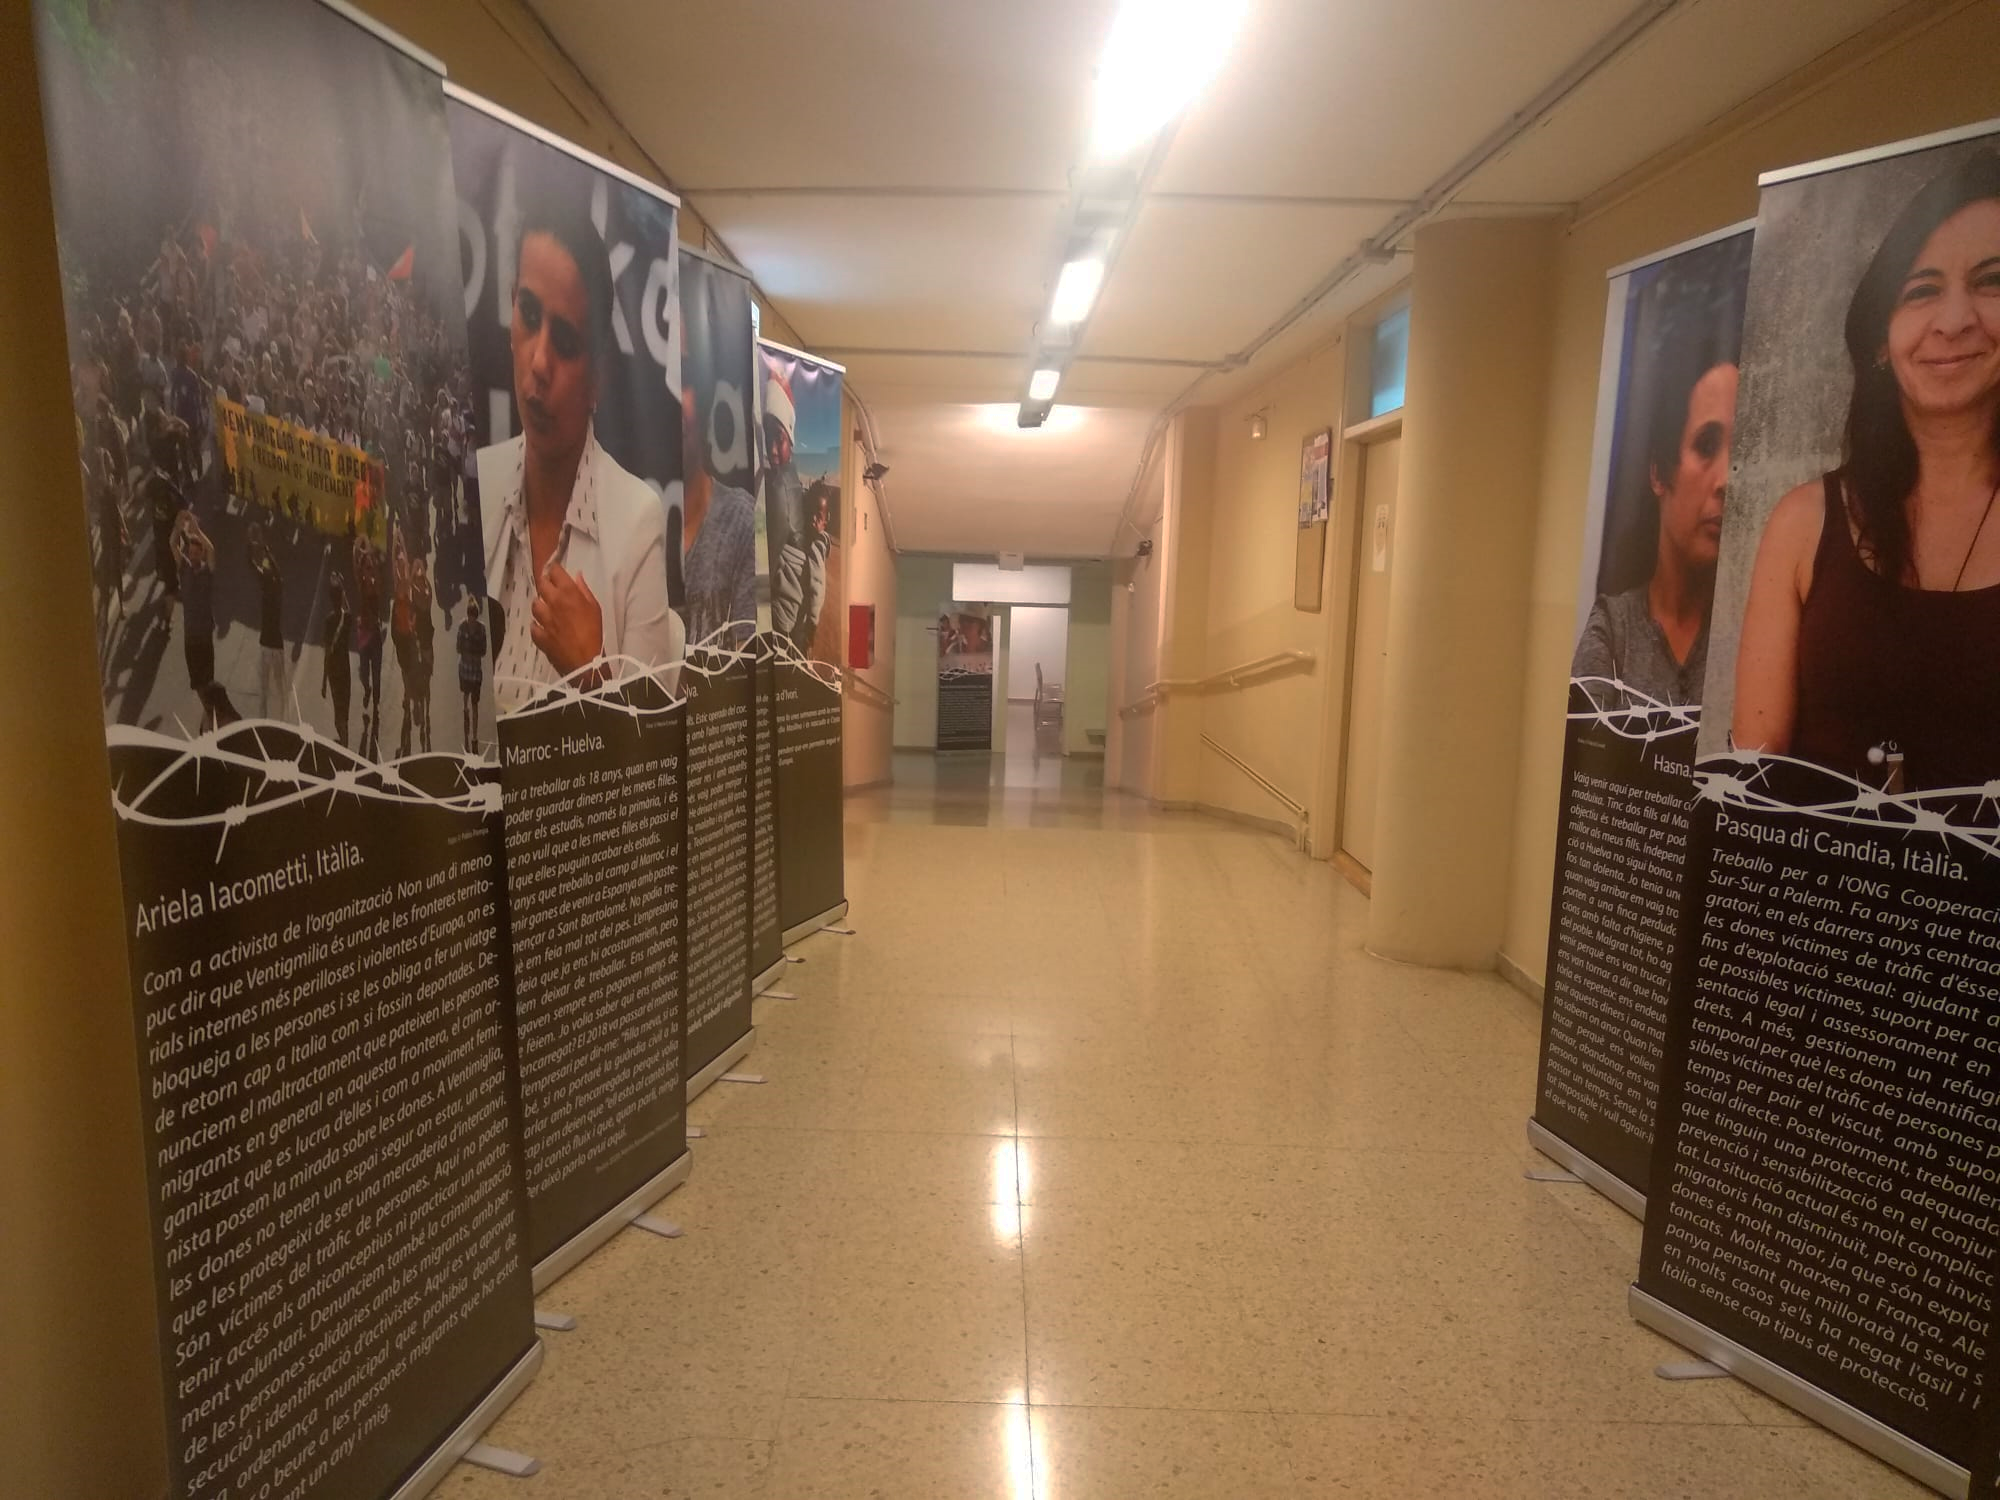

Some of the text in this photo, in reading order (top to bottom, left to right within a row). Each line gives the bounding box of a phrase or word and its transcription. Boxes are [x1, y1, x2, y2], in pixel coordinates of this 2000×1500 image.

[506, 745, 552, 767] Marroc
[562, 732, 605, 756] Huelva.
[1654, 754, 1692, 778] Hasna.
[136, 840, 364, 937] Ariela Iacometti, Itàlia.
[1712, 848, 1773, 873] Treballo
[1780, 866, 1808, 880] per
[1816, 874, 1828, 886] a
[1715, 812, 1969, 882] Pasqua di Candia, Itàlia.
[143, 965, 182, 995] Com
[189, 959, 201, 977] a
[209, 932, 277, 971] activista
[283, 920, 300, 943] de
[397, 879, 422, 900] Non
[426, 870, 445, 889] una
[448, 862, 457, 880] di
[460, 854, 492, 874] meno
[1703, 910, 1933, 983] les dones víctimes de tràfic
[1708, 869, 1962, 940] Sur-Sur a Palerm. Fa anys que
[146, 879, 493, 1037] puc dir que Ventigmilia és una de les fronteres territo-
[1701, 932, 1728, 951] fins
[1834, 972, 1896, 998] sexual:
[1902, 990, 1980, 1021] ajudant
[158, 974, 499, 1168] nunciem el maltractament que pateixen les persones
[1696, 977, 1990, 1076] sentació legal i assessorament en
[167, 1047, 503, 1268] nista posem la mirada sobre les dones. A Ventimiglia,
[1681, 1102, 1892, 1192] que tinguin una protecció
[176, 1117, 508, 1367] Són víctimes del tràfic de persones. Aquí no poden
[1663, 1243, 1680, 1259] en
[1686, 1254, 1726, 1282] molts
[1731, 1278, 1774, 1305] casos
[1818, 1317, 1841, 1340] ha
[1847, 1335, 1903, 1370] negat
